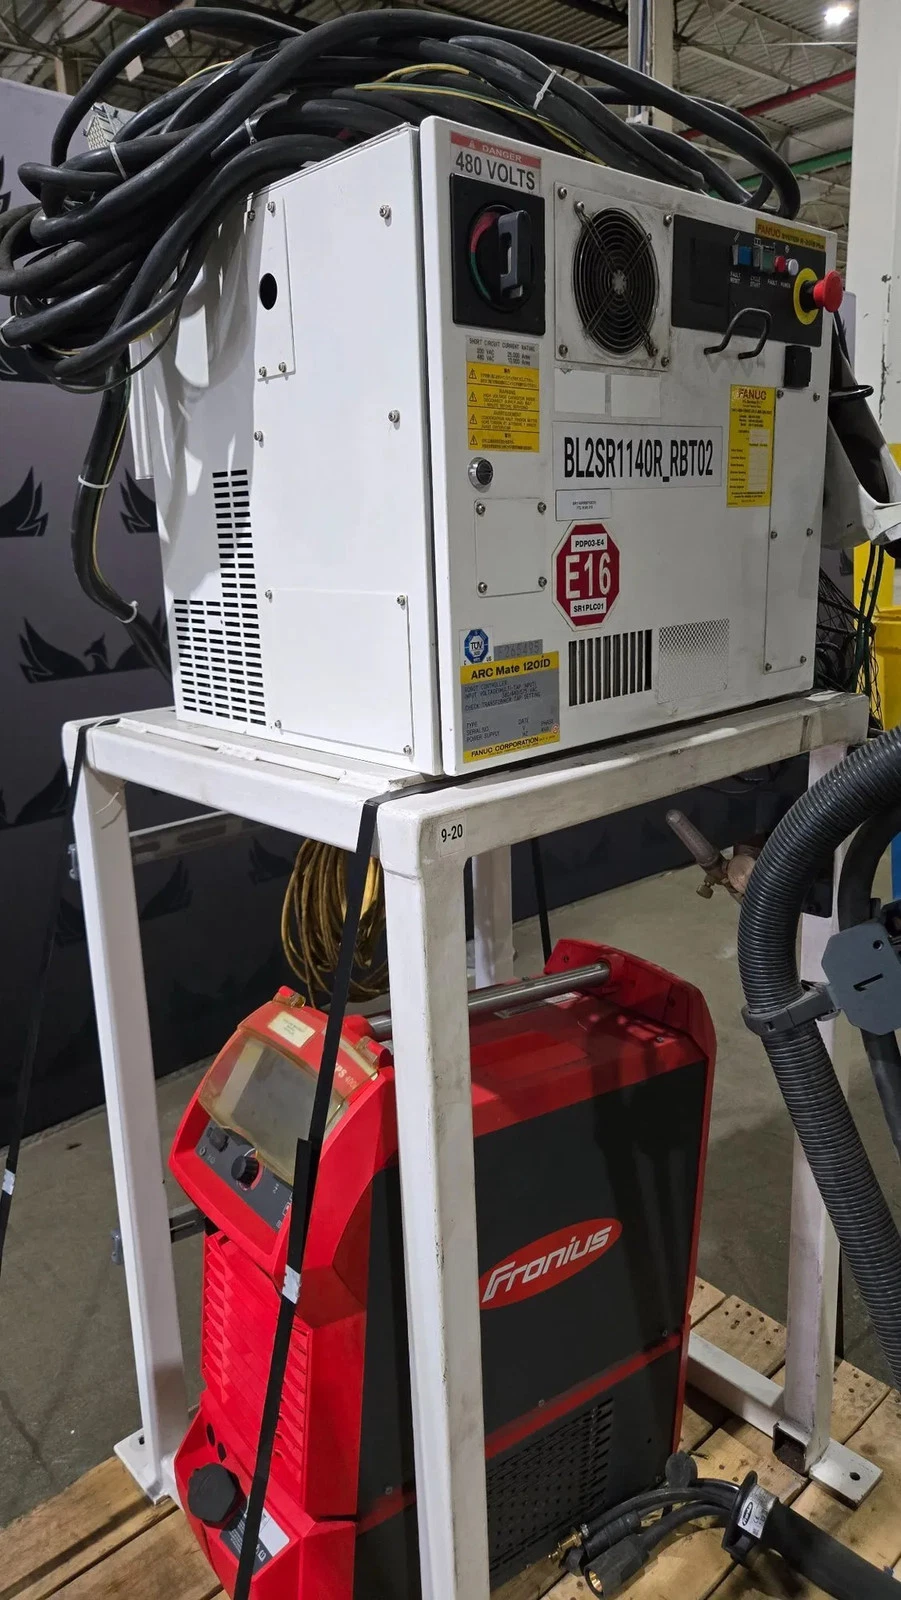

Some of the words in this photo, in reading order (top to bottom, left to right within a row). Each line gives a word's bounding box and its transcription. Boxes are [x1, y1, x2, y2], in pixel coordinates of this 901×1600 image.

[482, 145, 522, 162] DANGER
[456, 151, 482, 176] 480
[486, 159, 535, 190] VOLTS
[758, 224, 781, 237] FANUC
[484, 340, 500, 348] CIRCUIT
[502, 342, 520, 350] CURRENT
[738, 388, 767, 401] FANUC
[564, 436, 713, 482] BL2SR1140R_RBT02
[575, 538, 605, 548] PDP03-E4
[565, 552, 611, 599] E16
[573, 603, 604, 613] SR1PLC01
[471, 667, 494, 680] ARC
[496, 663, 520, 676] Mate
[523, 655, 551, 671] 120iD
[466, 721, 478, 729] TYPE
[466, 734, 482, 743] POWER
[484, 731, 500, 739] SUPPLY
[471, 747, 492, 757] FANUC
[494, 736, 539, 752] CORPORATION
[441, 823, 463, 843] 9-20
[481, 1225, 613, 1303] Fronius
